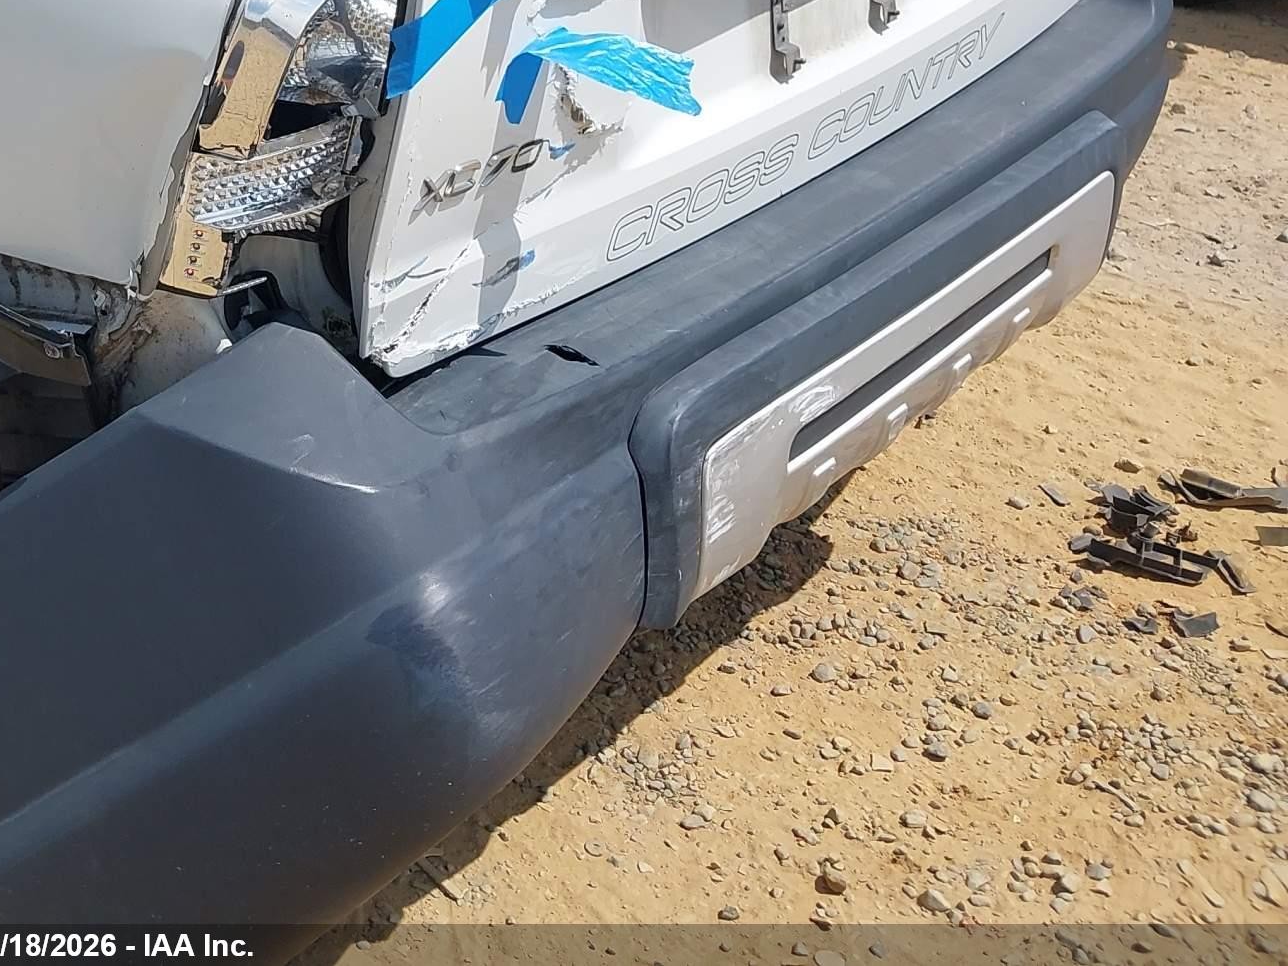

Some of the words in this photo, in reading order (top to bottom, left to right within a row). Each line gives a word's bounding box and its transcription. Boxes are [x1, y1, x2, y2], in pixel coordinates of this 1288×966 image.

[410, 139, 545, 212] XC70
[606, 133, 799, 262] CROSS
[807, 11, 1006, 161] COUNTRY
